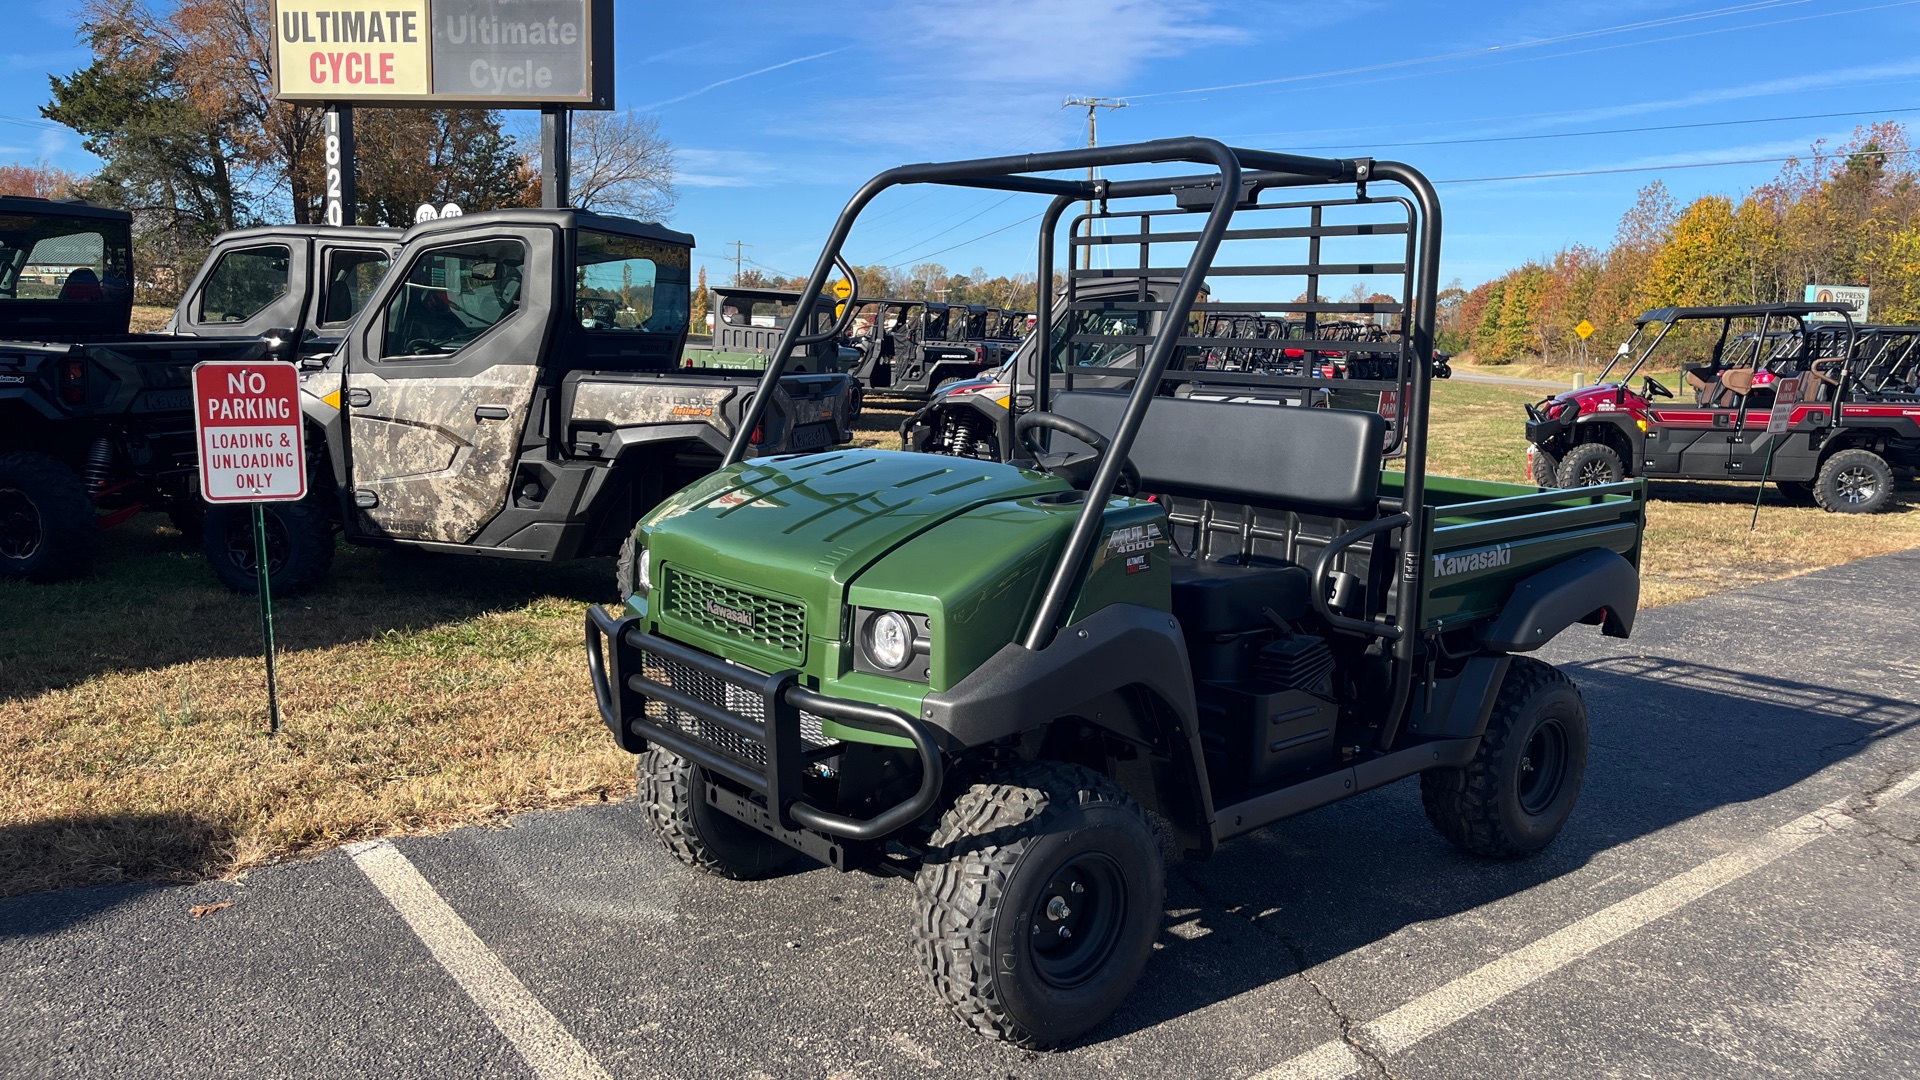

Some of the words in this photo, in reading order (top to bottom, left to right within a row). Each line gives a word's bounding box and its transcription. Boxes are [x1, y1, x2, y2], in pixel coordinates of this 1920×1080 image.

[282, 11, 418, 44] ULTIMATE
[446, 15, 578, 45] Ultimate
[309, 52, 395, 85] CYCLE
[469, 58, 553, 92] Cycle
[326, 104, 343, 227] 1820
[1835, 291, 1866, 300] CYPRESS
[227, 372, 266, 394] NO
[1784, 382, 1793, 392] NO
[208, 397, 290, 419] PARKING
[650, 395, 714, 406] RIDGE
[212, 433, 273, 449] LOADING
[280, 432, 291, 448] &
[790, 427, 826, 449] Kawasaki
[212, 452, 293, 469] UNLOADING
[236, 473, 273, 489] ONLY
[375, 518, 433, 532] awasaki
[1107, 523, 1163, 549] MULE
[1117, 540, 1155, 554] 4000
[1432, 542, 1512, 578] Kawasaki
[706, 598, 753, 627] Kawasaki
